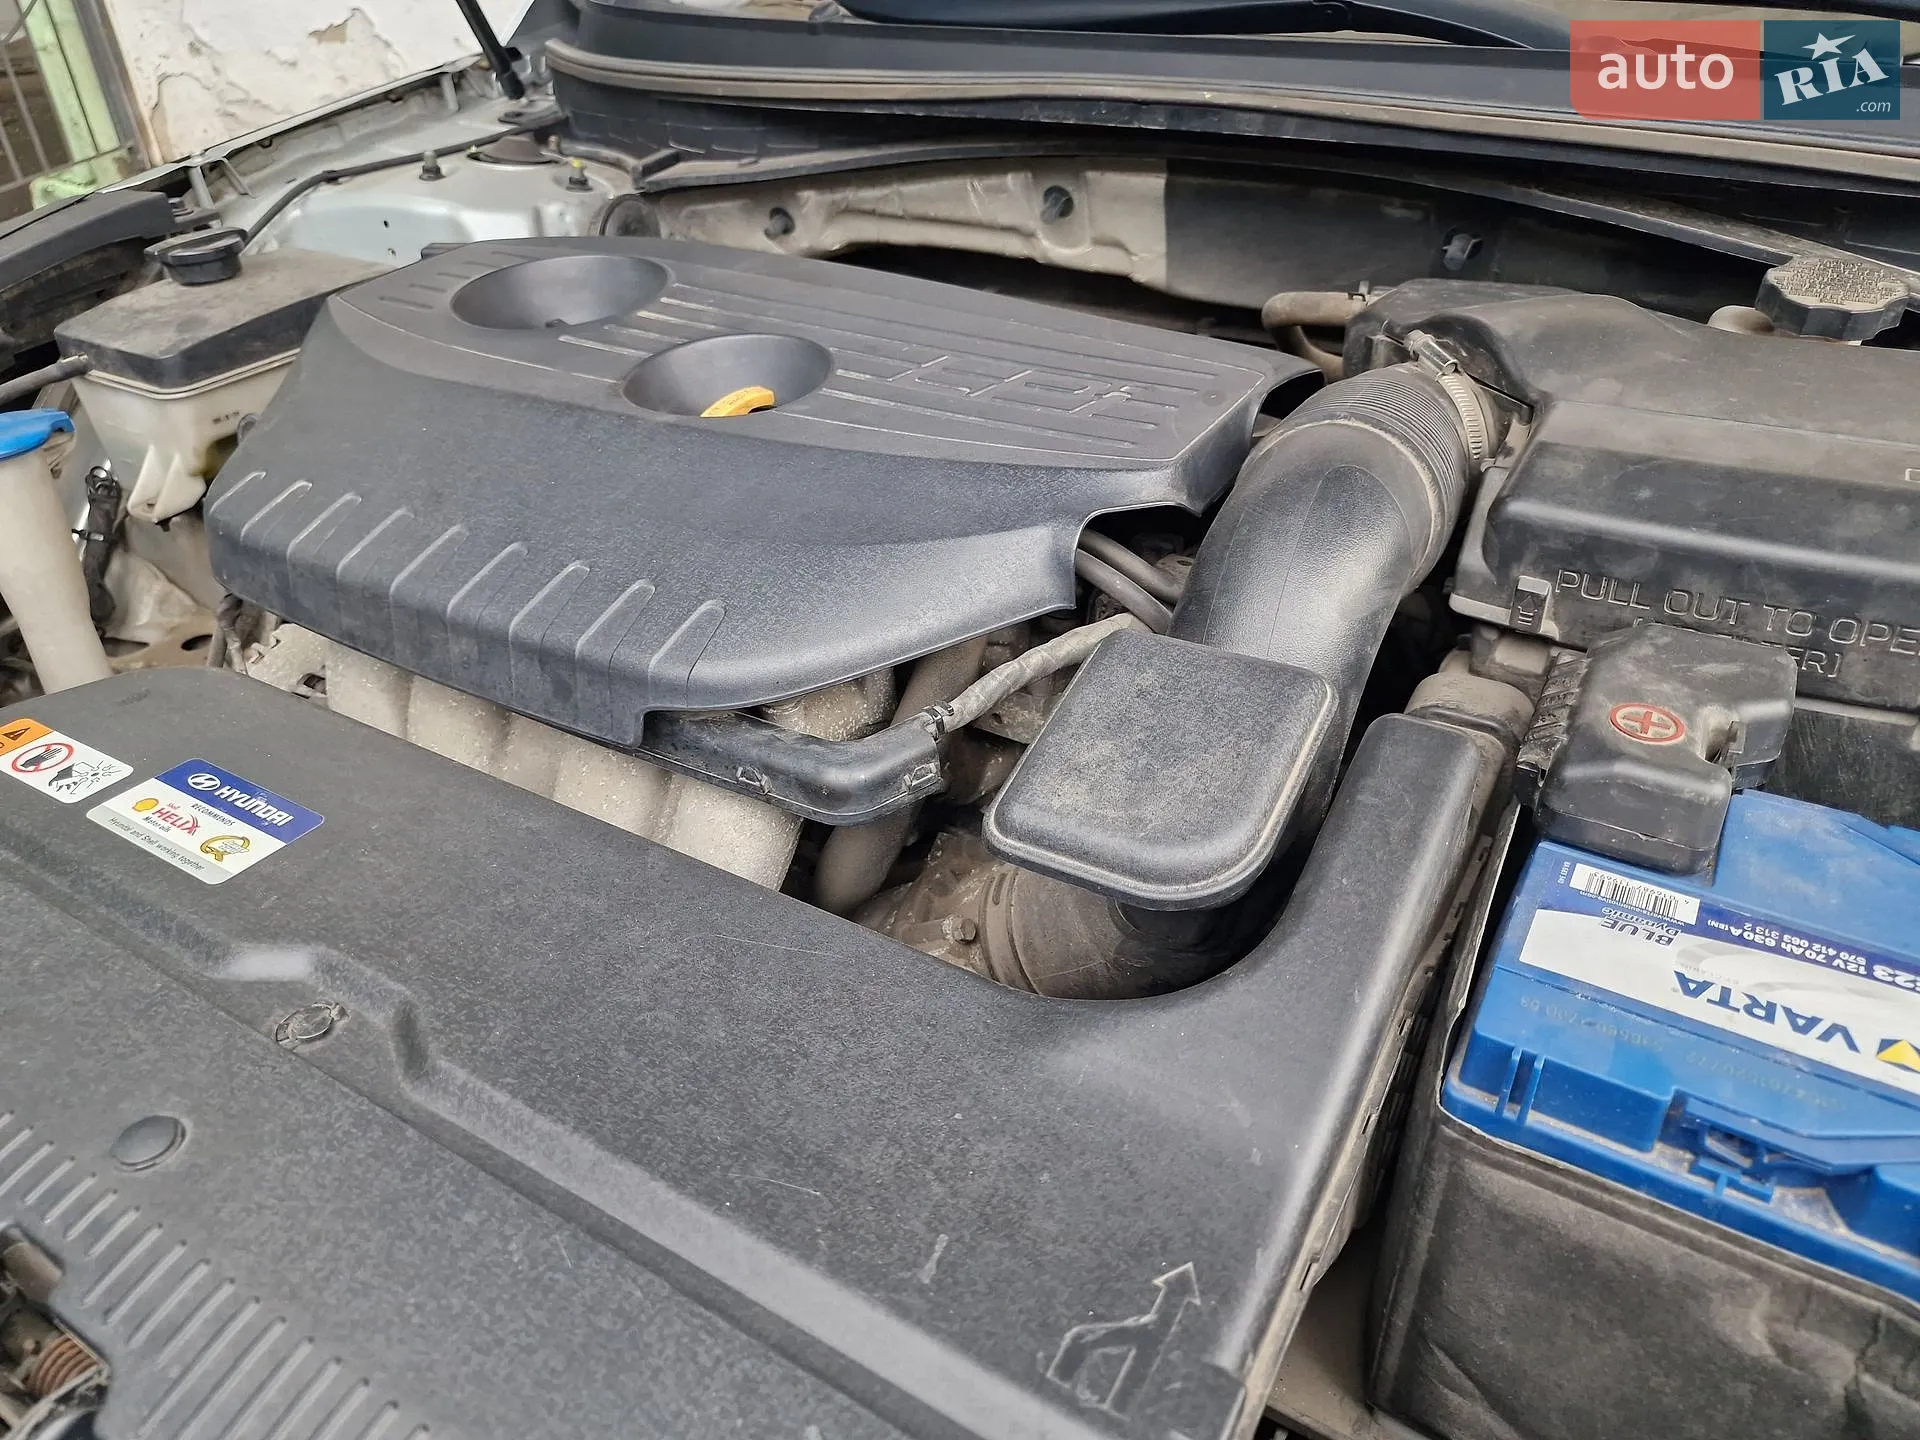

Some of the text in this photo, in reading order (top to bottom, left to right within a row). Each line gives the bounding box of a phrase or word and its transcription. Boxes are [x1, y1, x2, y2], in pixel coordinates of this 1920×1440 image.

[1554, 569, 1651, 611] PULL
[1663, 588, 1750, 626] OUT
[1763, 604, 1814, 638] TO
[1828, 616, 1920, 656] OPE
[191, 803, 236, 827] RECOMMENDS
[214, 785, 296, 827] HYUNDAI
[152, 807, 200, 836] HELIX
[1600, 917, 1675, 946] BLUE
[1601, 907, 1681, 938] Dynamic
[1743, 922, 1753, 931] 2
[1756, 926, 1779, 939] 313
[1780, 942, 1828, 963] 70Ah
[1812, 943, 1837, 956] 412
[1839, 951, 1867, 965] 570
[1832, 958, 1867, 975] 12V
[1673, 969, 1861, 1054] VARTA
